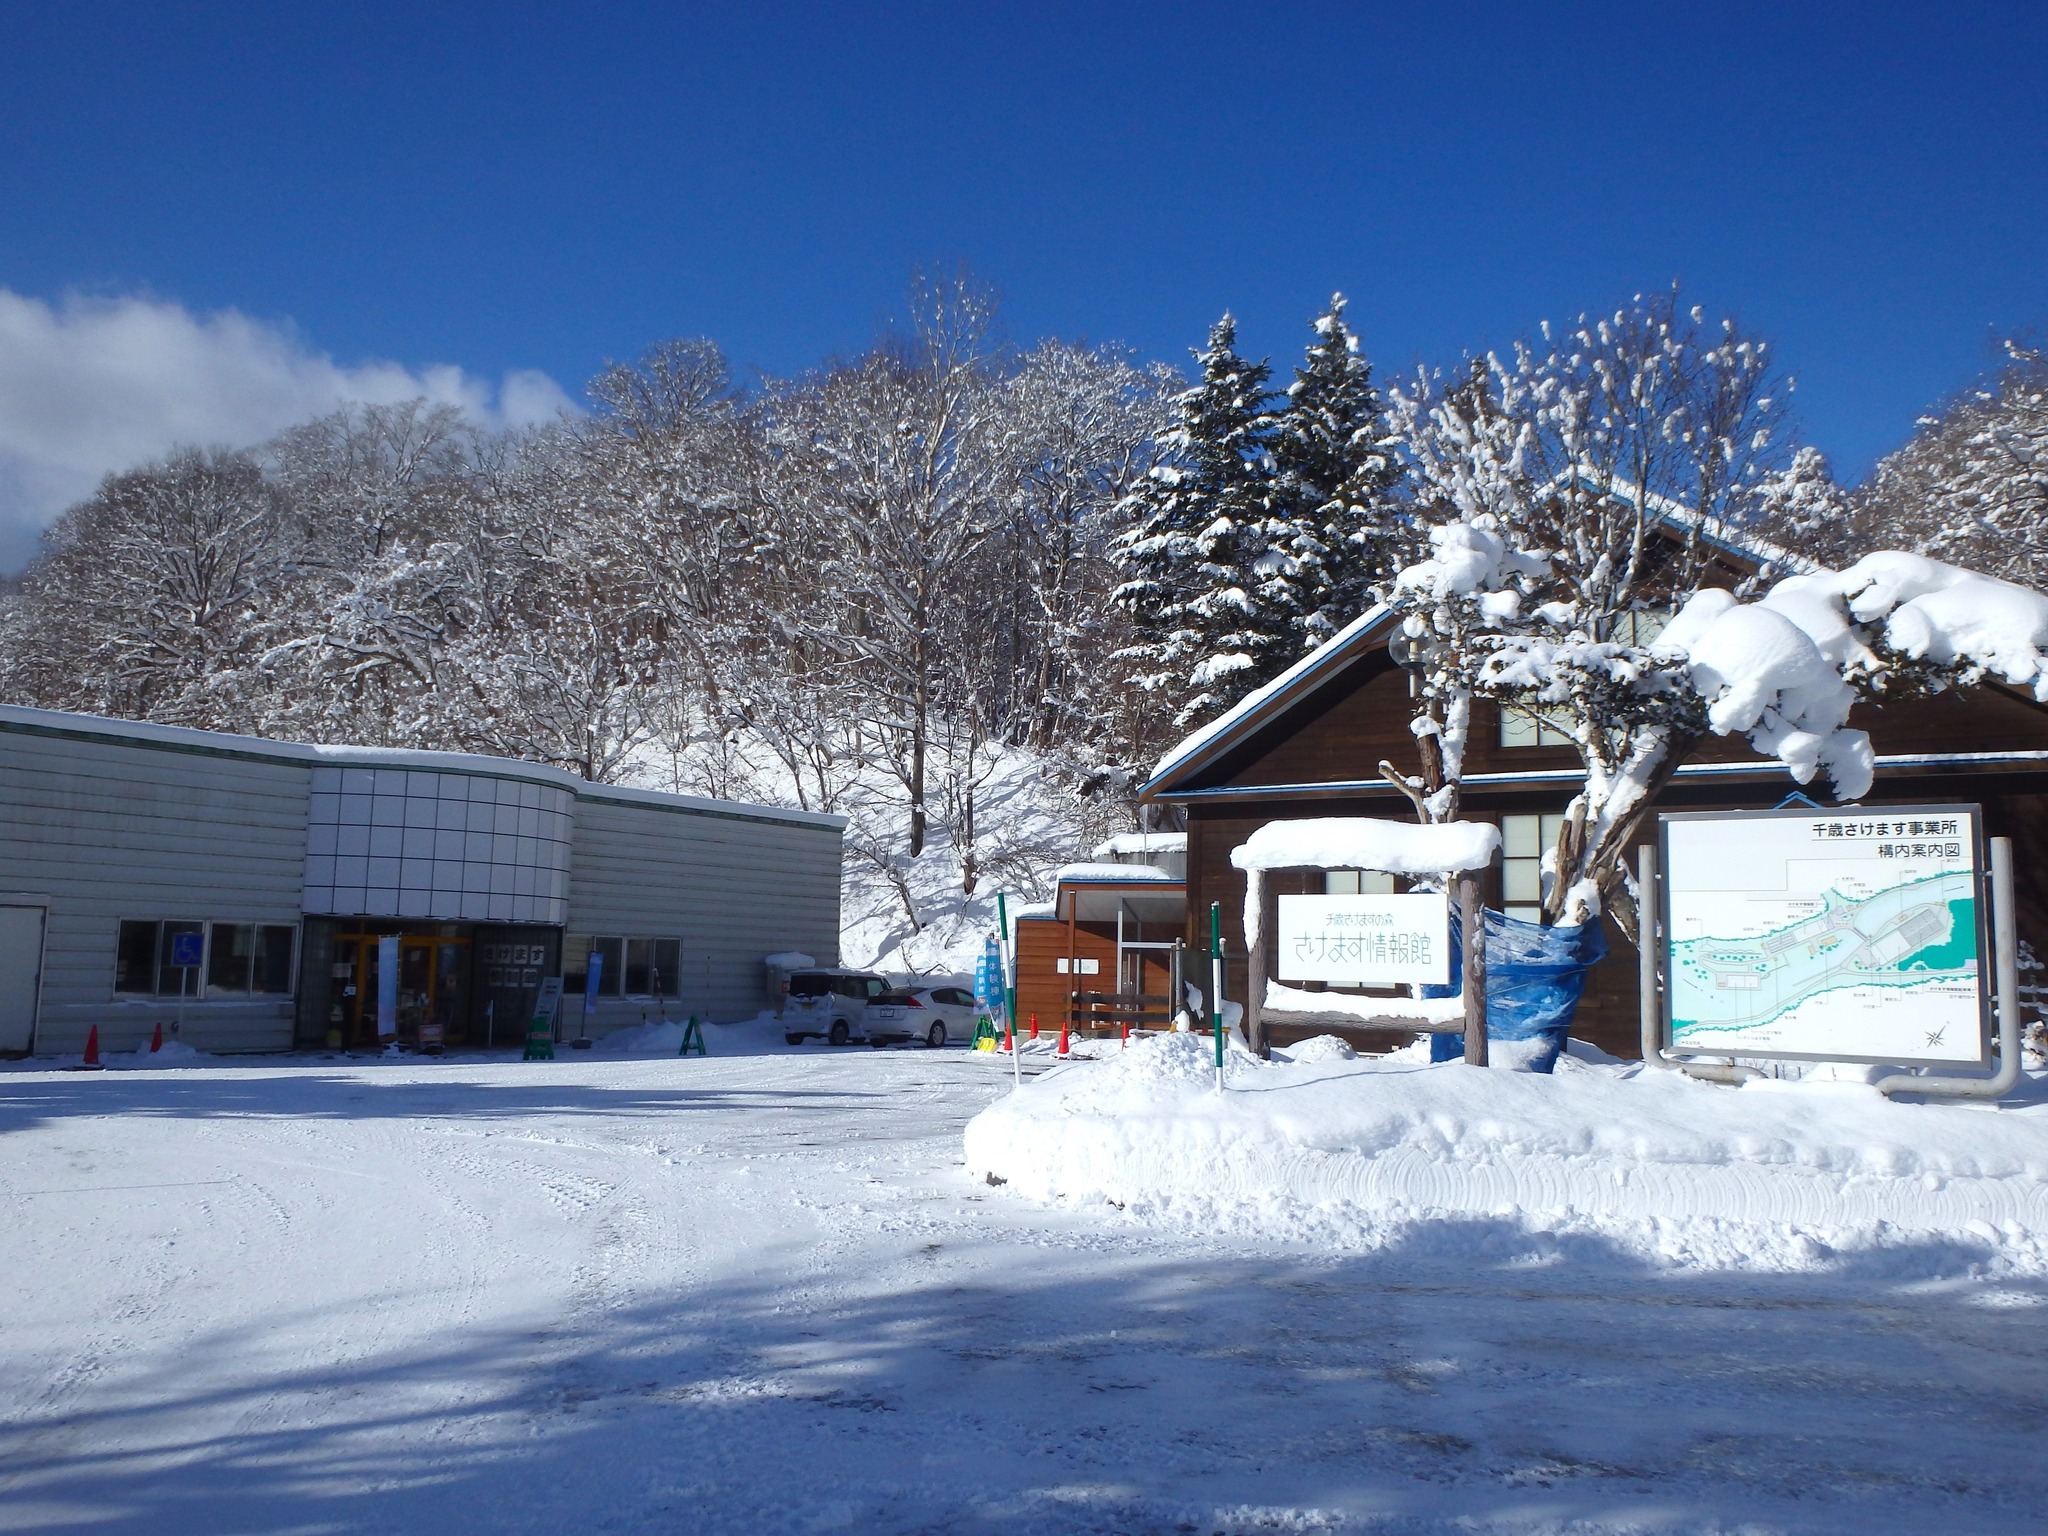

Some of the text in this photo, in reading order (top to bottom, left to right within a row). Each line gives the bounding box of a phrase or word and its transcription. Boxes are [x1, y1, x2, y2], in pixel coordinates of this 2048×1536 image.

[1812, 819, 1958, 837] 千歳さけます事業所
[1878, 842, 1960, 858] 構内案内図
[1325, 912, 1395, 927] 千歳さけますの森
[1293, 931, 1432, 965] さけます情報館
